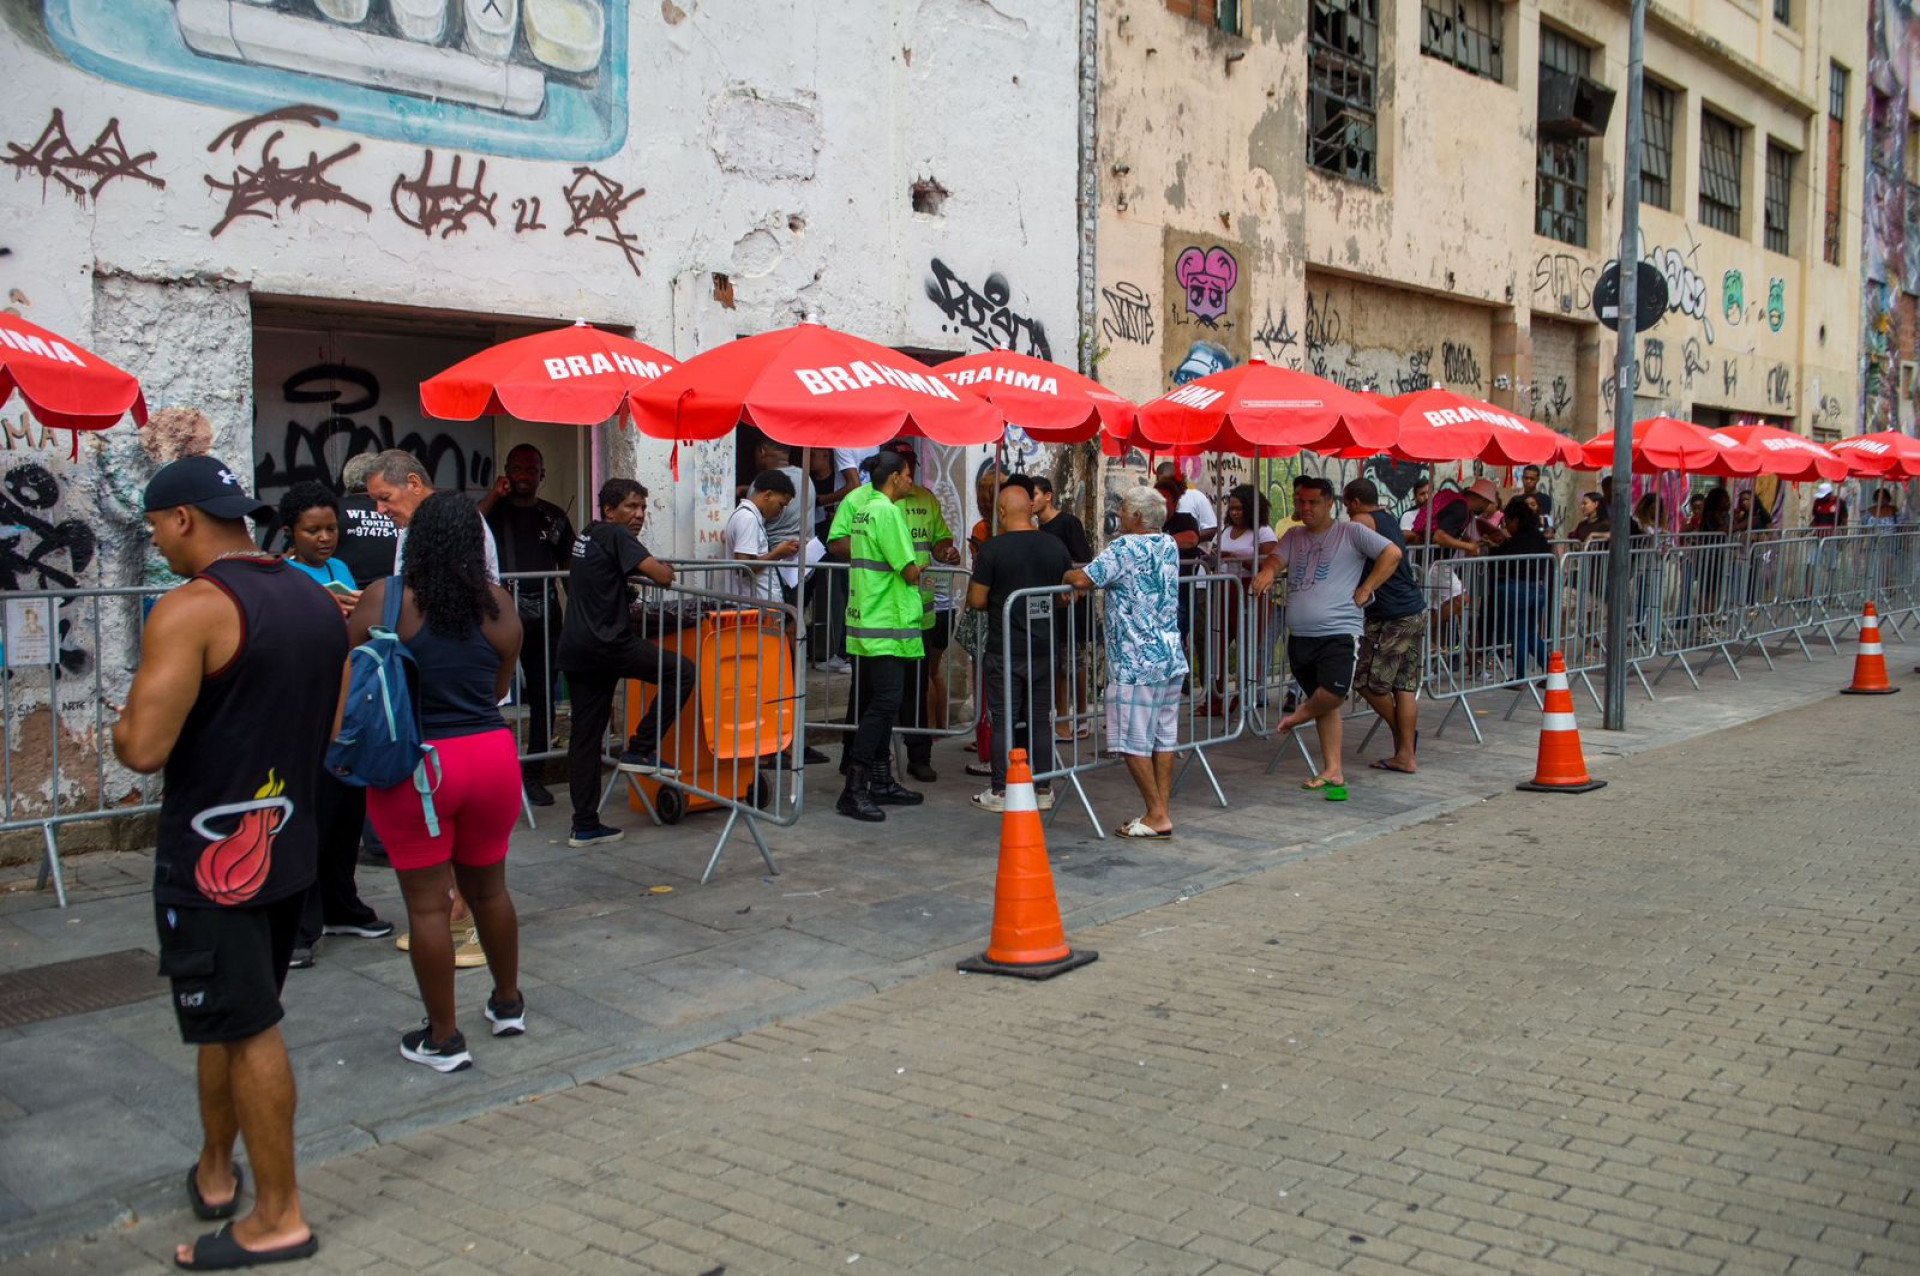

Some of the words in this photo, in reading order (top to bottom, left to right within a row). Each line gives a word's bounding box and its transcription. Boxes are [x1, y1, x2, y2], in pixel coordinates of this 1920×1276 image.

[794, 360, 960, 402] BRAHMA
[0, 411, 60, 451] MA
[1423, 406, 1530, 434] BRAHMA
[346, 509, 369, 519] WL
[911, 527, 928, 539] GIA
